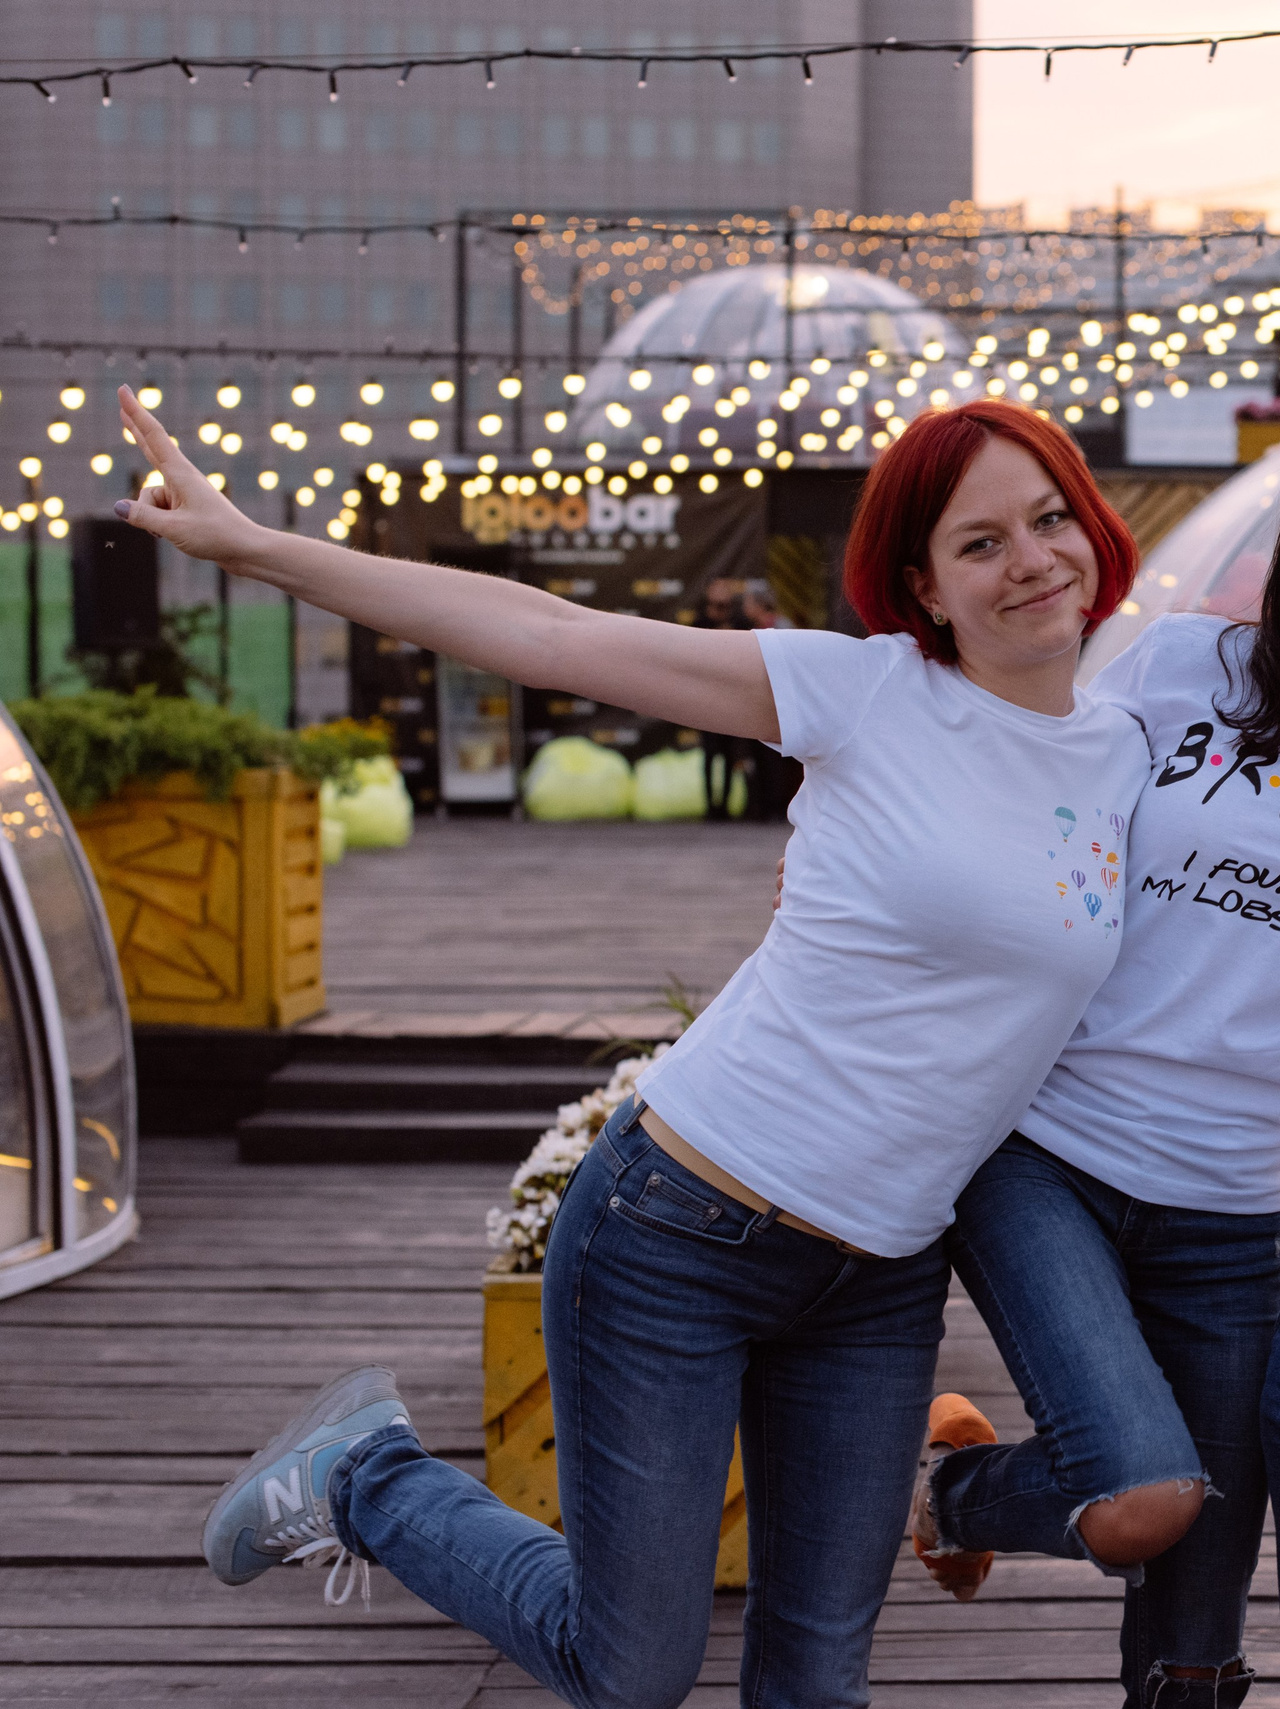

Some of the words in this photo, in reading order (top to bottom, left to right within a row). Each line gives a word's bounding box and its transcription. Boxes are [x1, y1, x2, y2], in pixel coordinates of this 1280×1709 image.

[1183, 850, 1198, 872] I
[1141, 875, 1186, 901] MY
[264, 1465, 304, 1524] N
